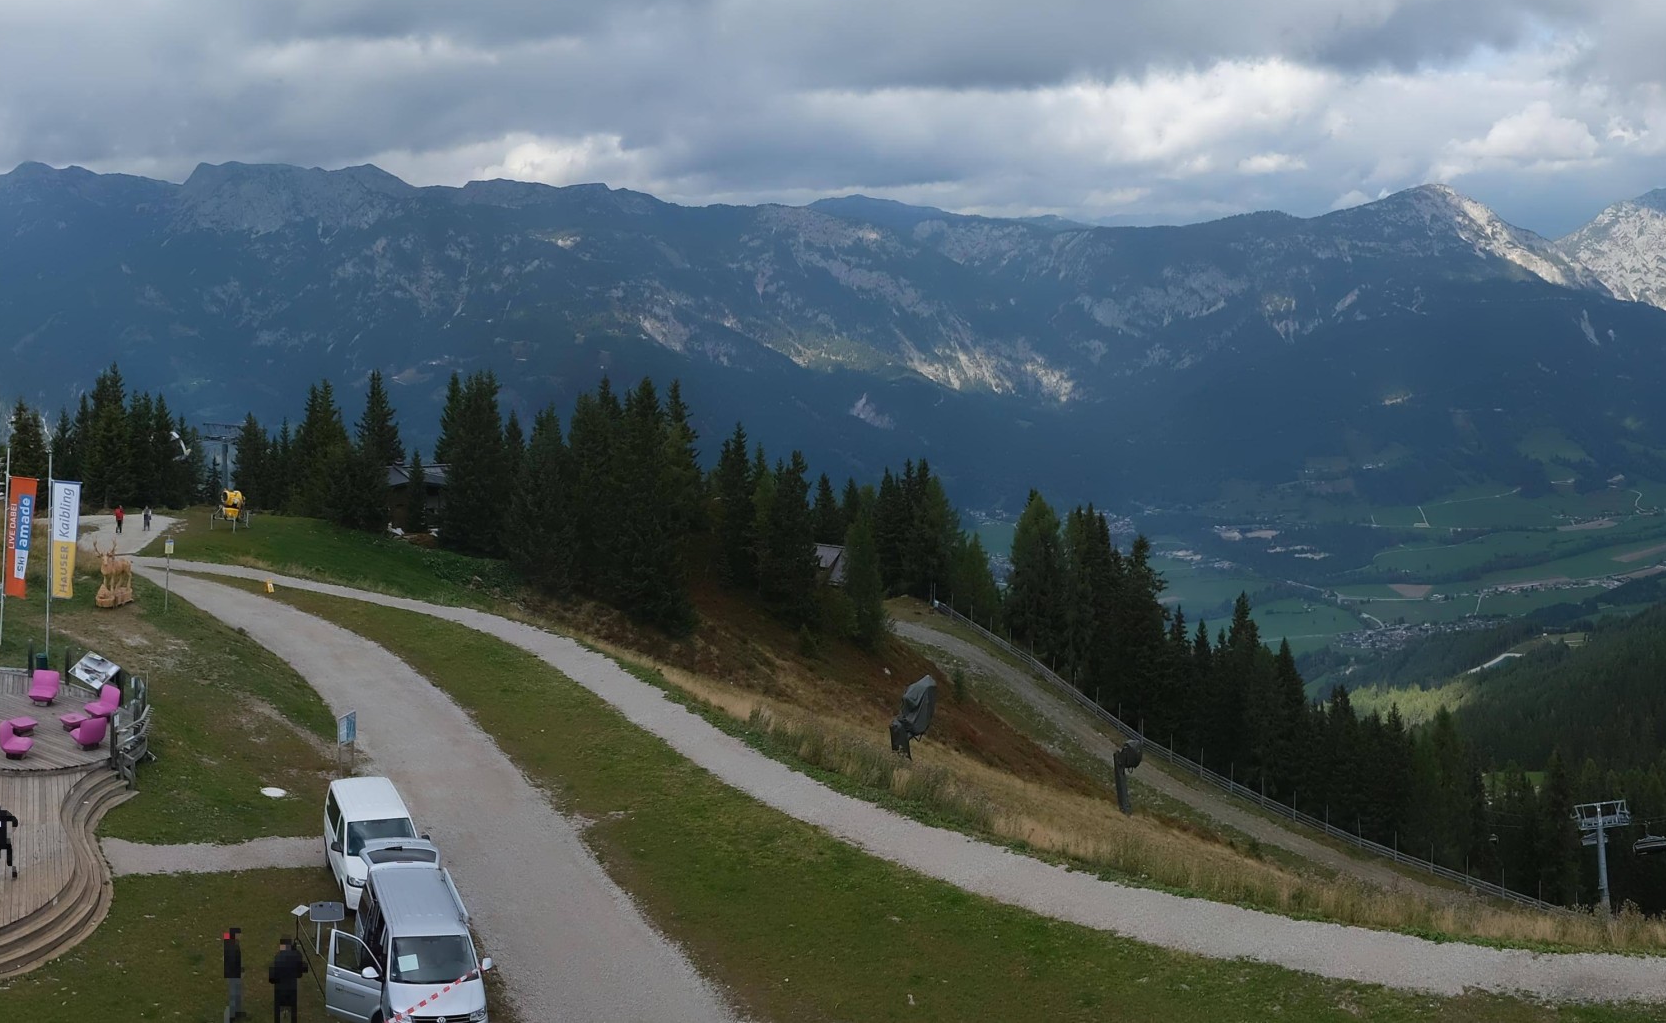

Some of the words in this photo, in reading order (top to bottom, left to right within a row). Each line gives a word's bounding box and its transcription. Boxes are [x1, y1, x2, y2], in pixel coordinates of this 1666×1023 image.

[9, 503, 17, 528] DABEI
[58, 487, 75, 538] Kaibling
[8, 530, 16, 549] LIVE
[59, 545, 69, 593] HAUSER
